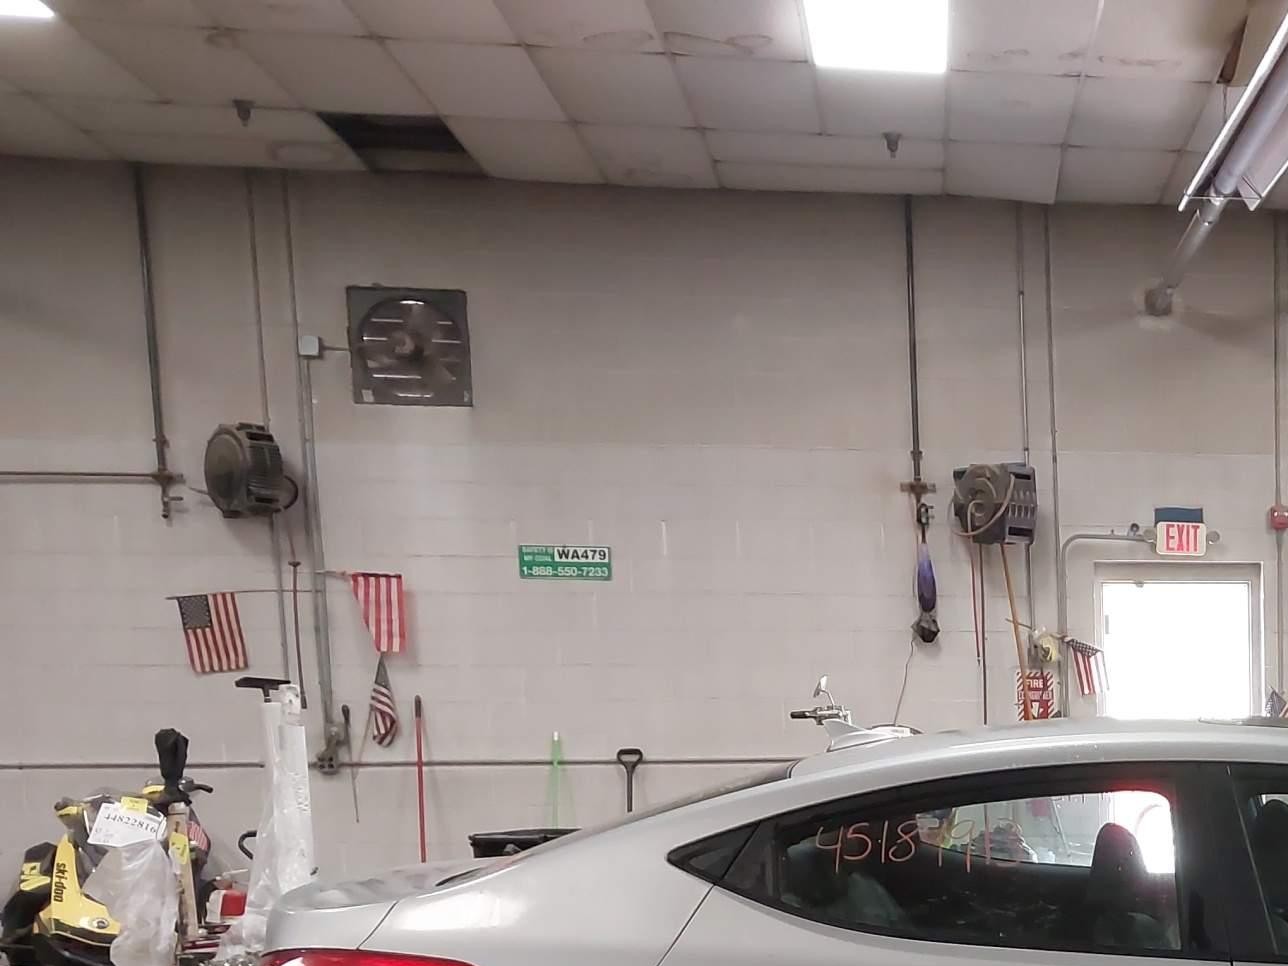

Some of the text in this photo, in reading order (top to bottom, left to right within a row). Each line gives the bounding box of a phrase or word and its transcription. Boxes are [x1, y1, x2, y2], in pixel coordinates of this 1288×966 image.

[1165, 523, 1201, 552] EXIT
[556, 548, 607, 561] WA479
[521, 566, 609, 577] 1-888-550-7233
[103, 813, 158, 833] 44822816
